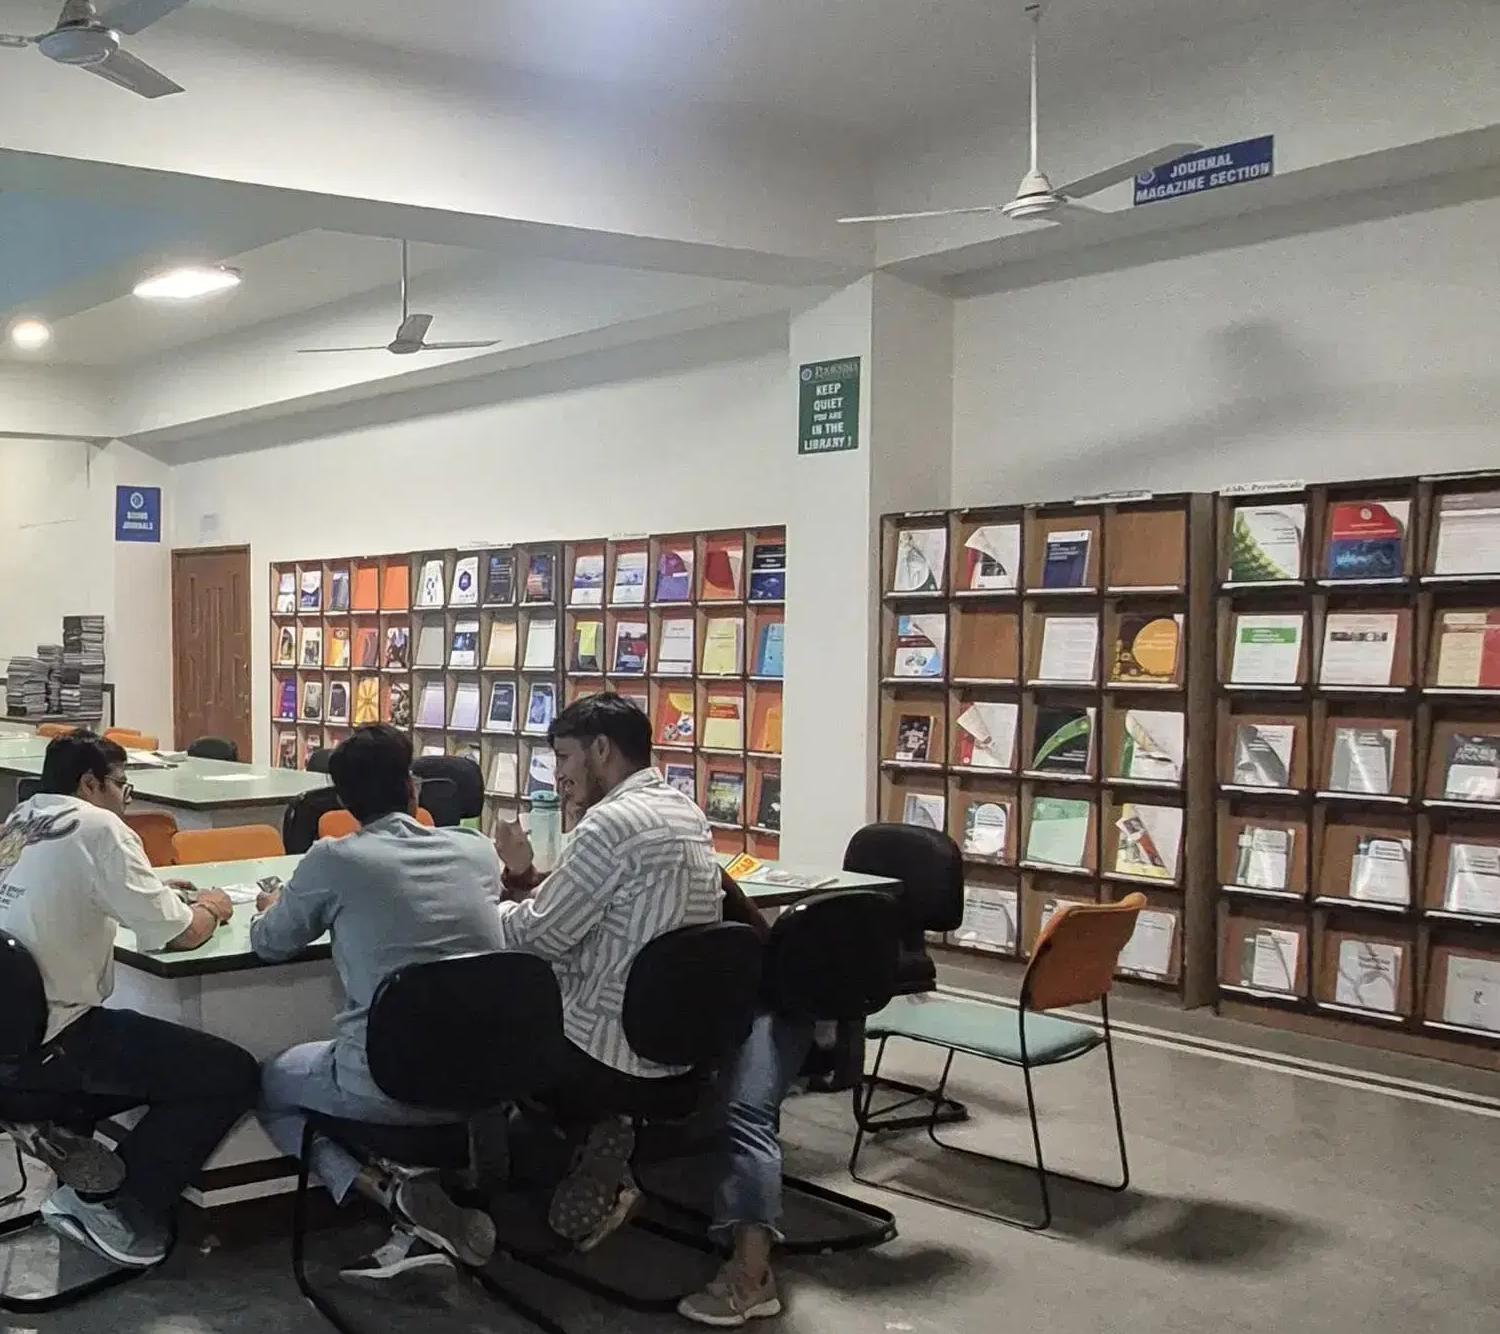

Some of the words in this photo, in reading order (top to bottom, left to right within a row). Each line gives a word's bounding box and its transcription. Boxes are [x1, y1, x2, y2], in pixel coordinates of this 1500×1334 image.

[1170, 153, 1234, 179] JOURNAL
[1136, 176, 1205, 202] MAGAZINE
[1209, 161, 1271, 187] SECTION
[816, 383, 842, 396] KEEP
[813, 397, 844, 411] QUIET
[812, 424, 822, 435] IN
[825, 422, 844, 434] THE
[804, 437, 845, 450] LIBRARY
